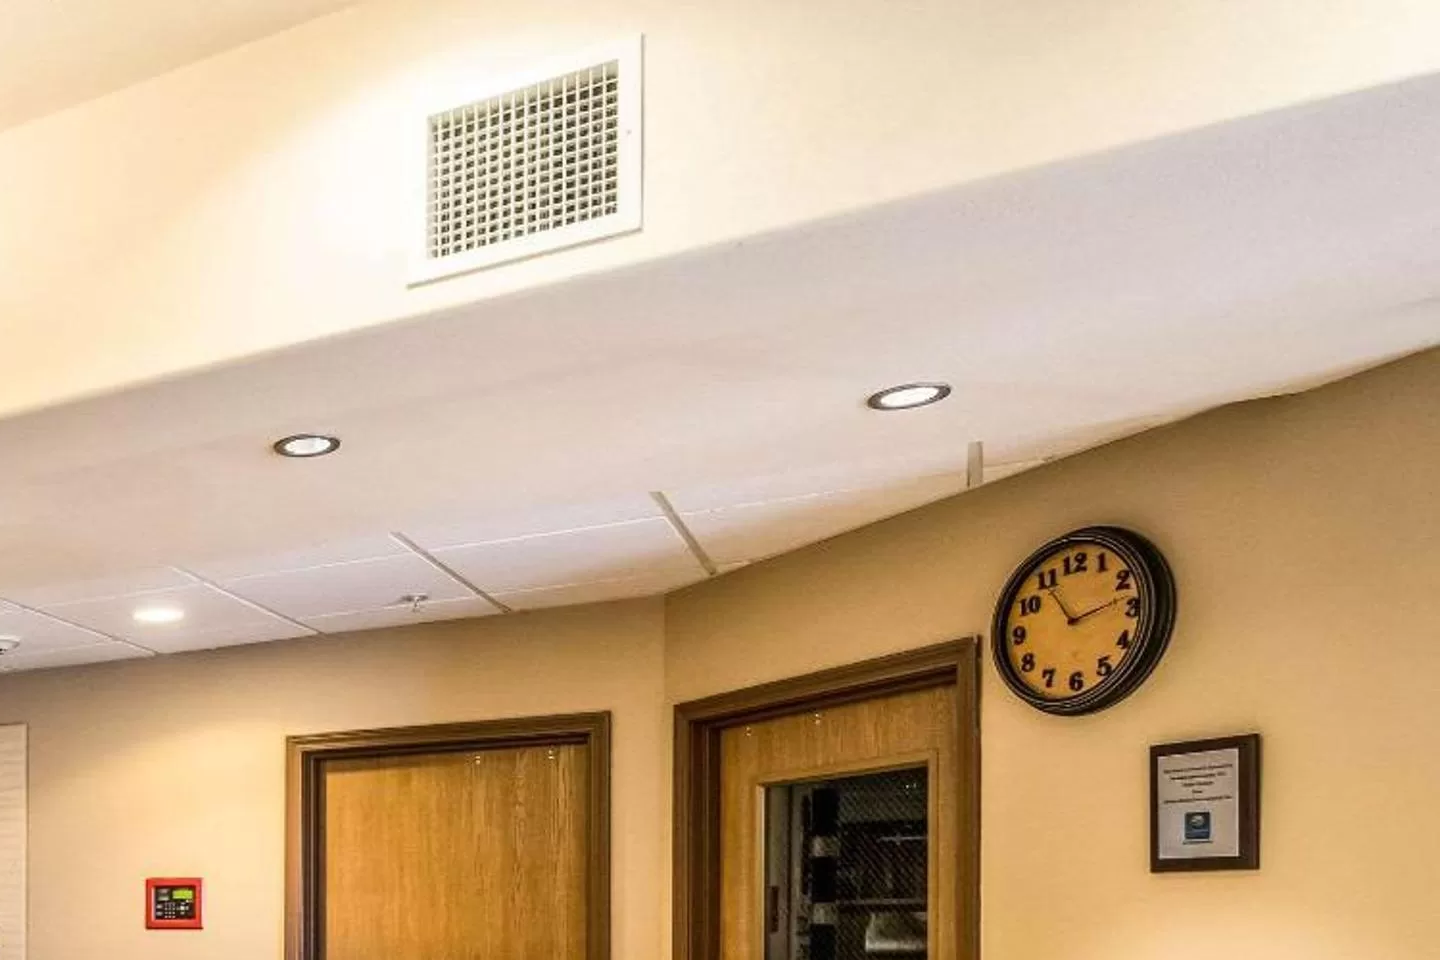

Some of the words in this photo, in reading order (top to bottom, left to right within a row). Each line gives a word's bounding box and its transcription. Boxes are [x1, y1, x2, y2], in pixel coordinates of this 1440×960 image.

[1063, 552, 1087, 576] 12
[1096, 552, 1108, 573] 1
[1038, 568, 1060, 590] 11
[1115, 569, 1131, 591] 2
[1019, 595, 1042, 616] 10
[1125, 598, 1141, 618] 3
[1013, 625, 1026, 645] 9
[1116, 629, 1130, 650] 4
[1021, 652, 1035, 673] 8
[1096, 655, 1112, 677] 5
[1042, 668, 1056, 688] 7
[1069, 671, 1084, 691] 6
